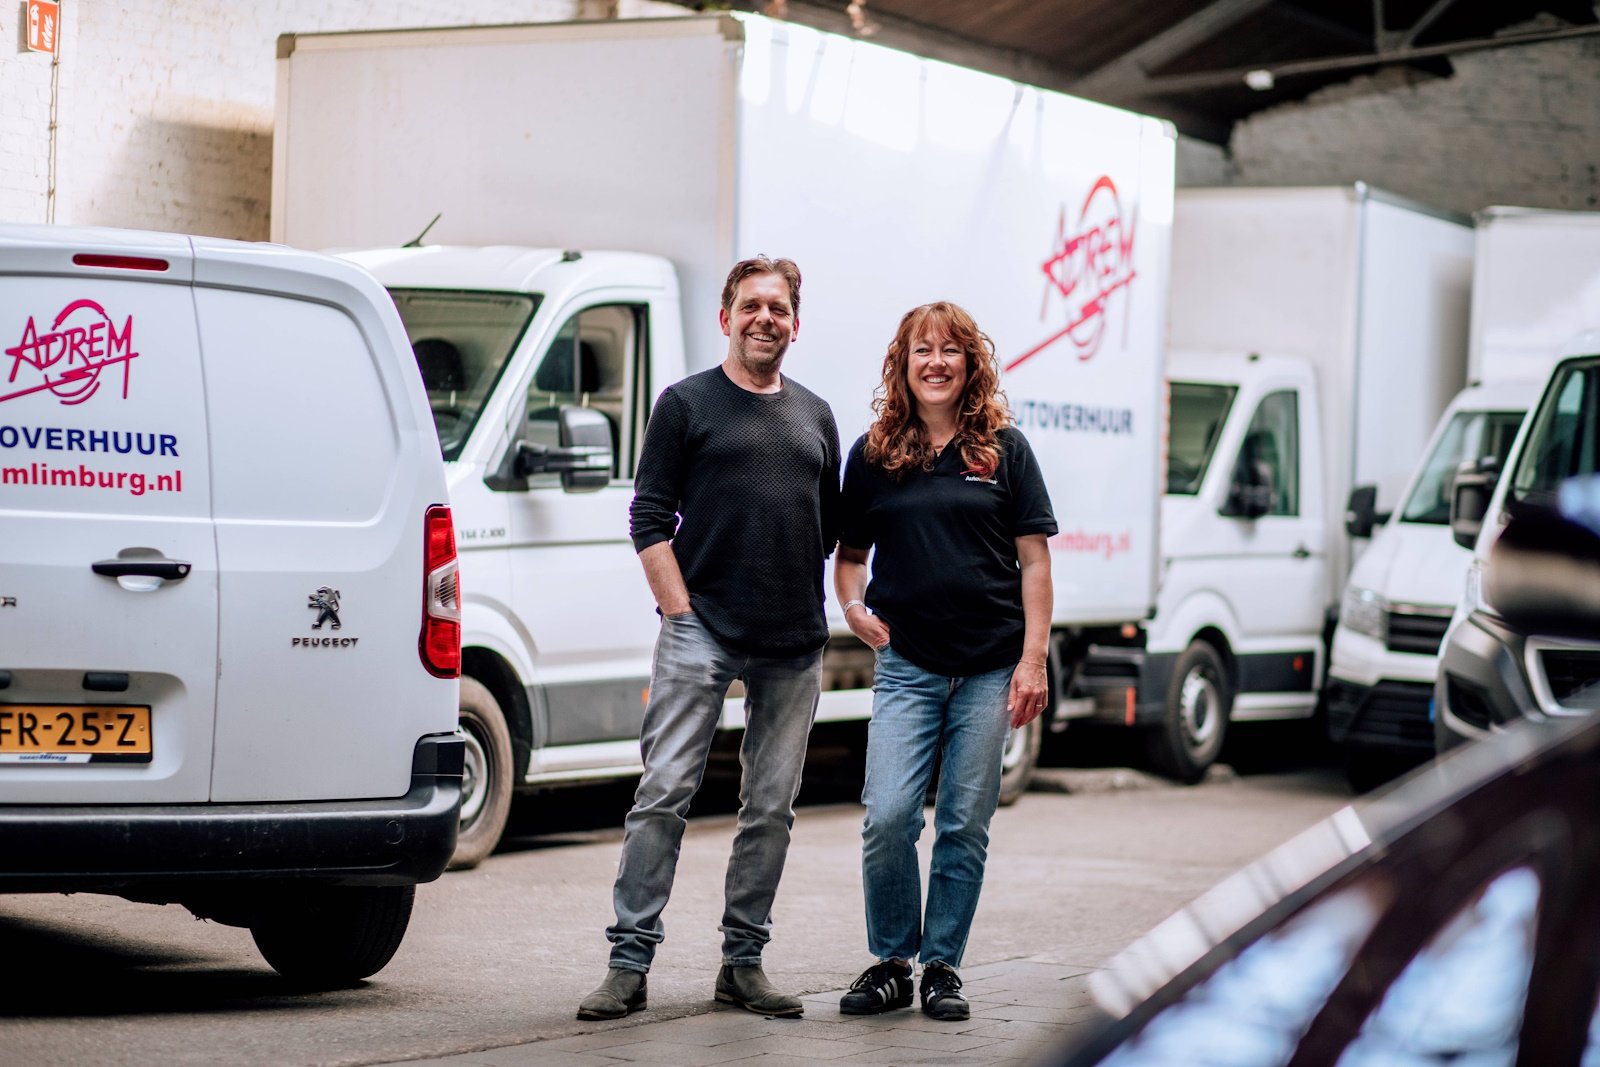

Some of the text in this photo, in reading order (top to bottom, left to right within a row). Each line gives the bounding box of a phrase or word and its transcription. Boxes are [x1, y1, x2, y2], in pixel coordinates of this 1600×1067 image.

[4, 314, 138, 400] ADREM
[1011, 399, 1134, 433] UTOVERHUUR
[0, 425, 179, 457] OVERHUUR
[2, 463, 182, 496] mlimburg.nl
[291, 637, 359, 648] PEUGEOT
